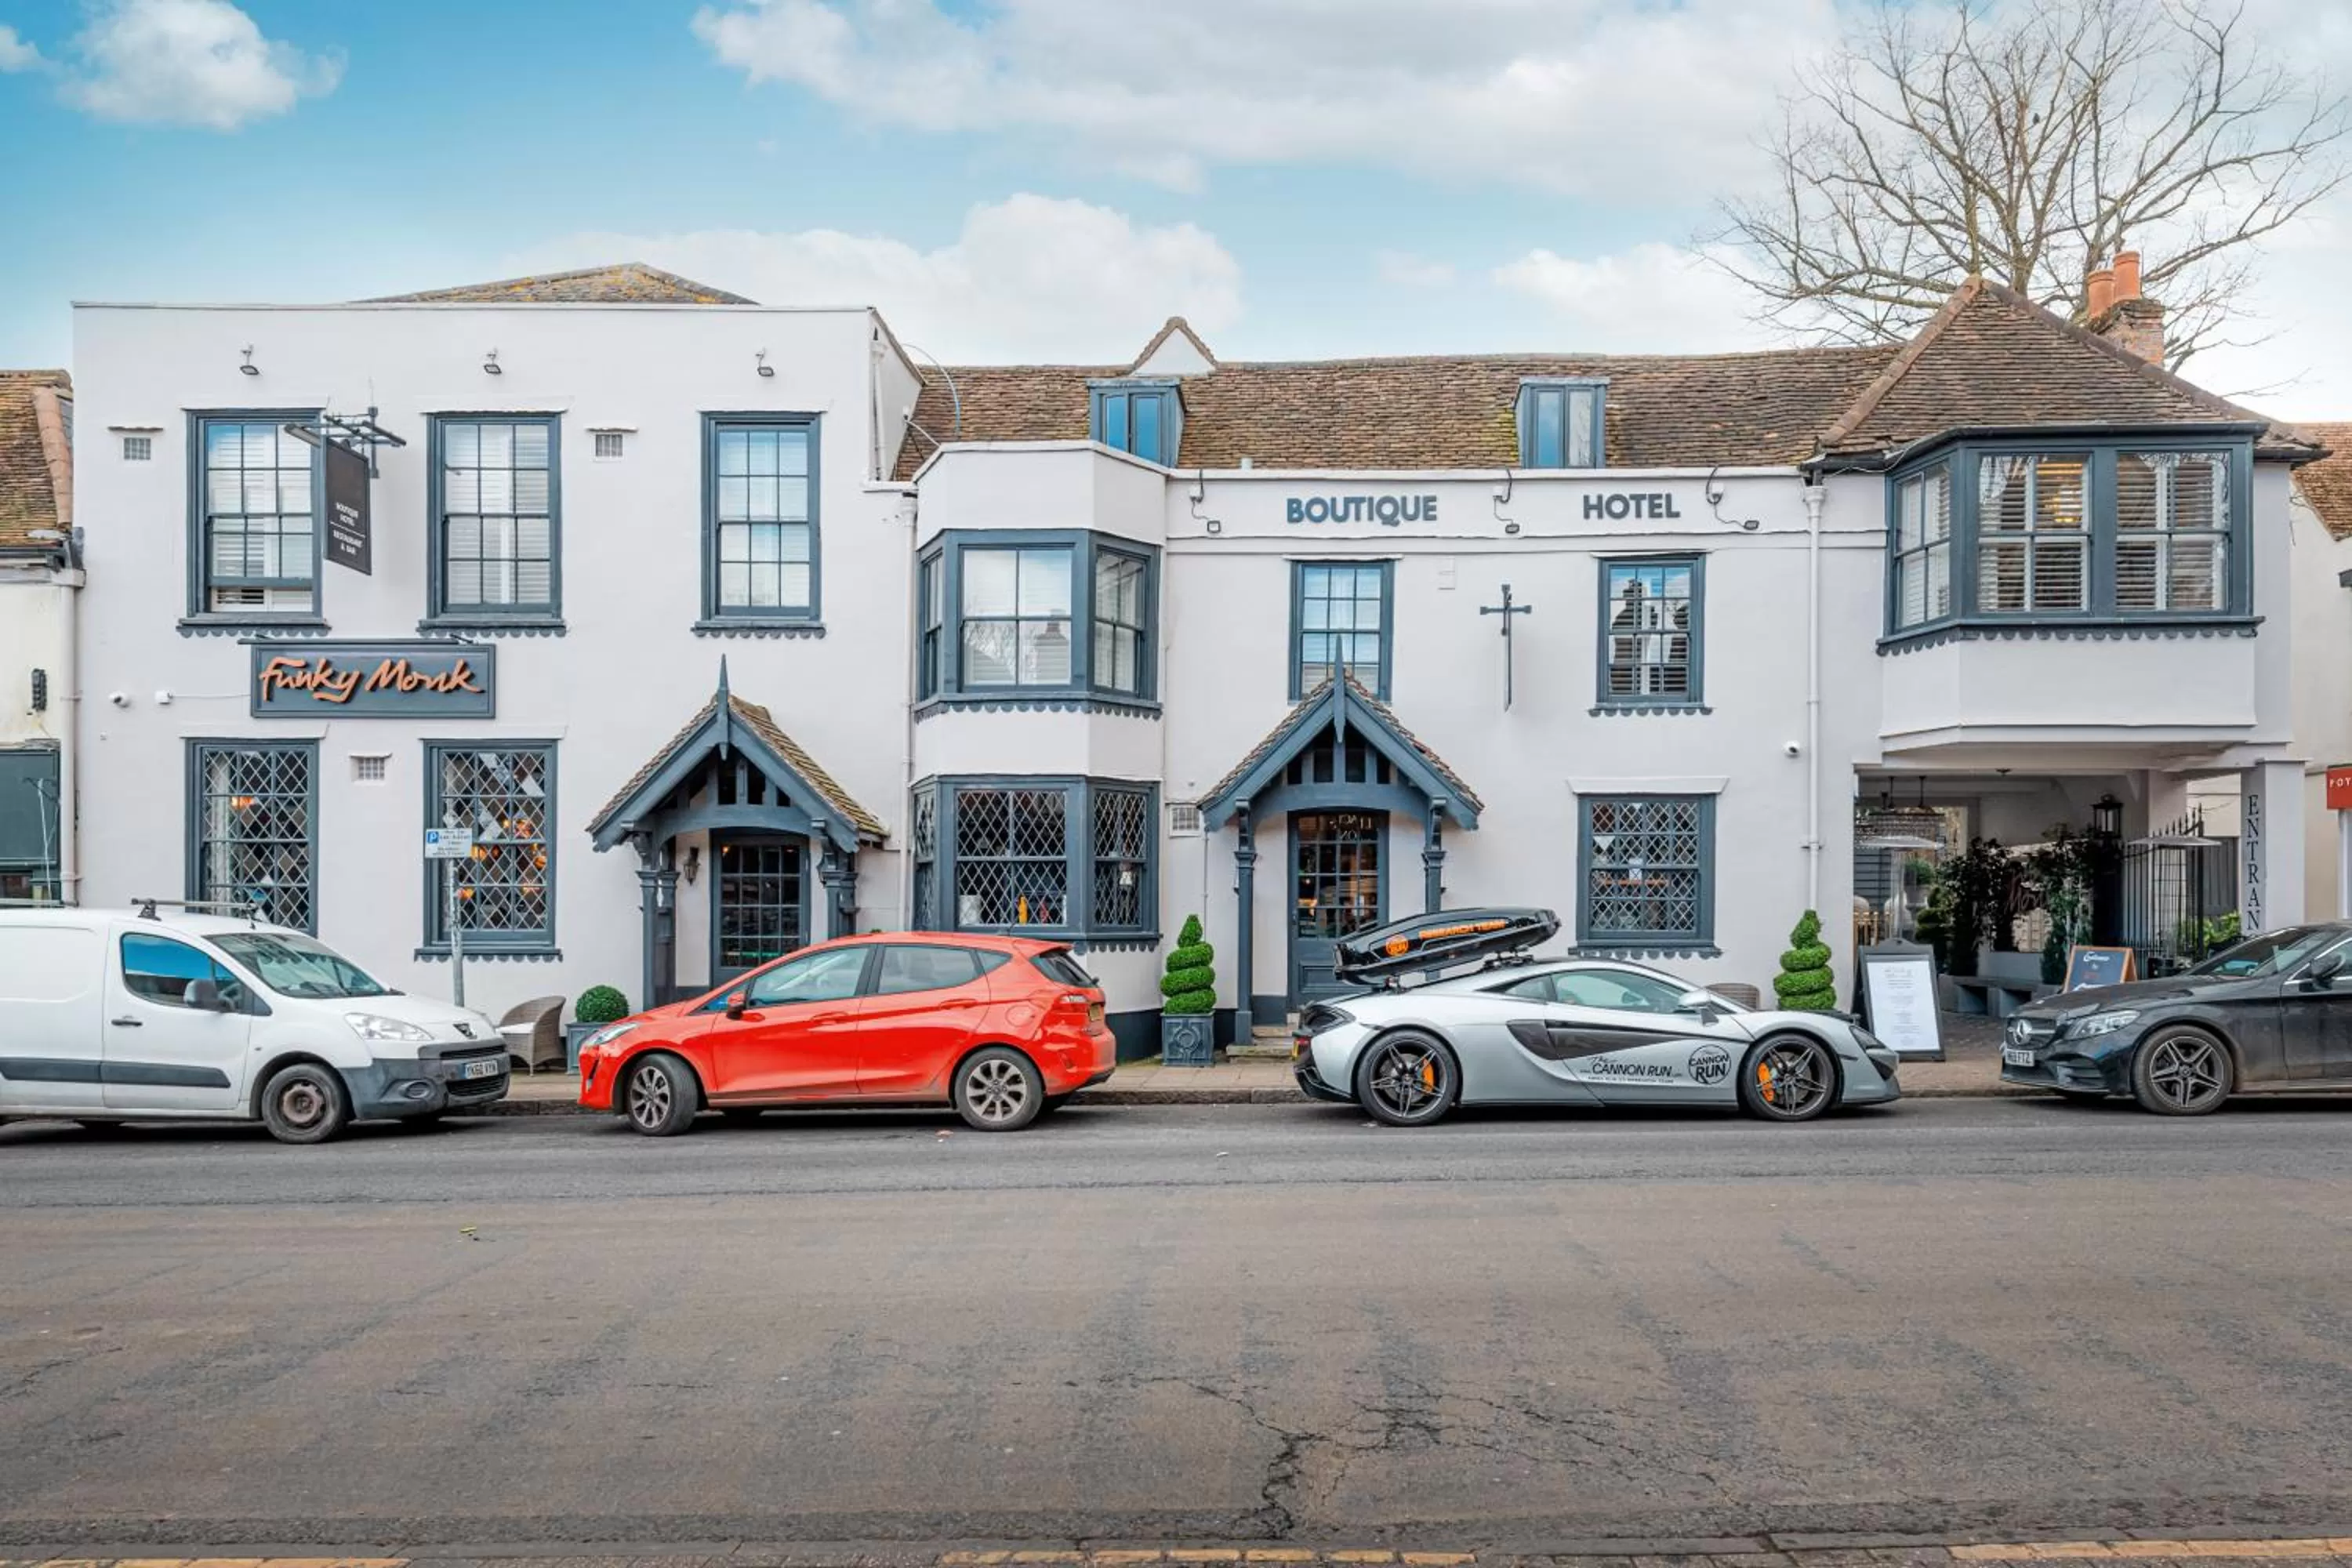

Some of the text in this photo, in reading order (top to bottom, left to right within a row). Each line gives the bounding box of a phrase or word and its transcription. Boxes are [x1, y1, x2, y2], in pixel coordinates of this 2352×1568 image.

[1287, 493, 1680, 526] BOUTIQUE HOTEL
[365, 659, 485, 693] Monk
[2245, 794, 2260, 938] ENTRAN
[1592, 1062, 1646, 1076] CANNON
[1647, 1065, 1672, 1077] RUN
[1688, 1053, 1730, 1066] CANNON
[1696, 1063, 1726, 1085] RUN
